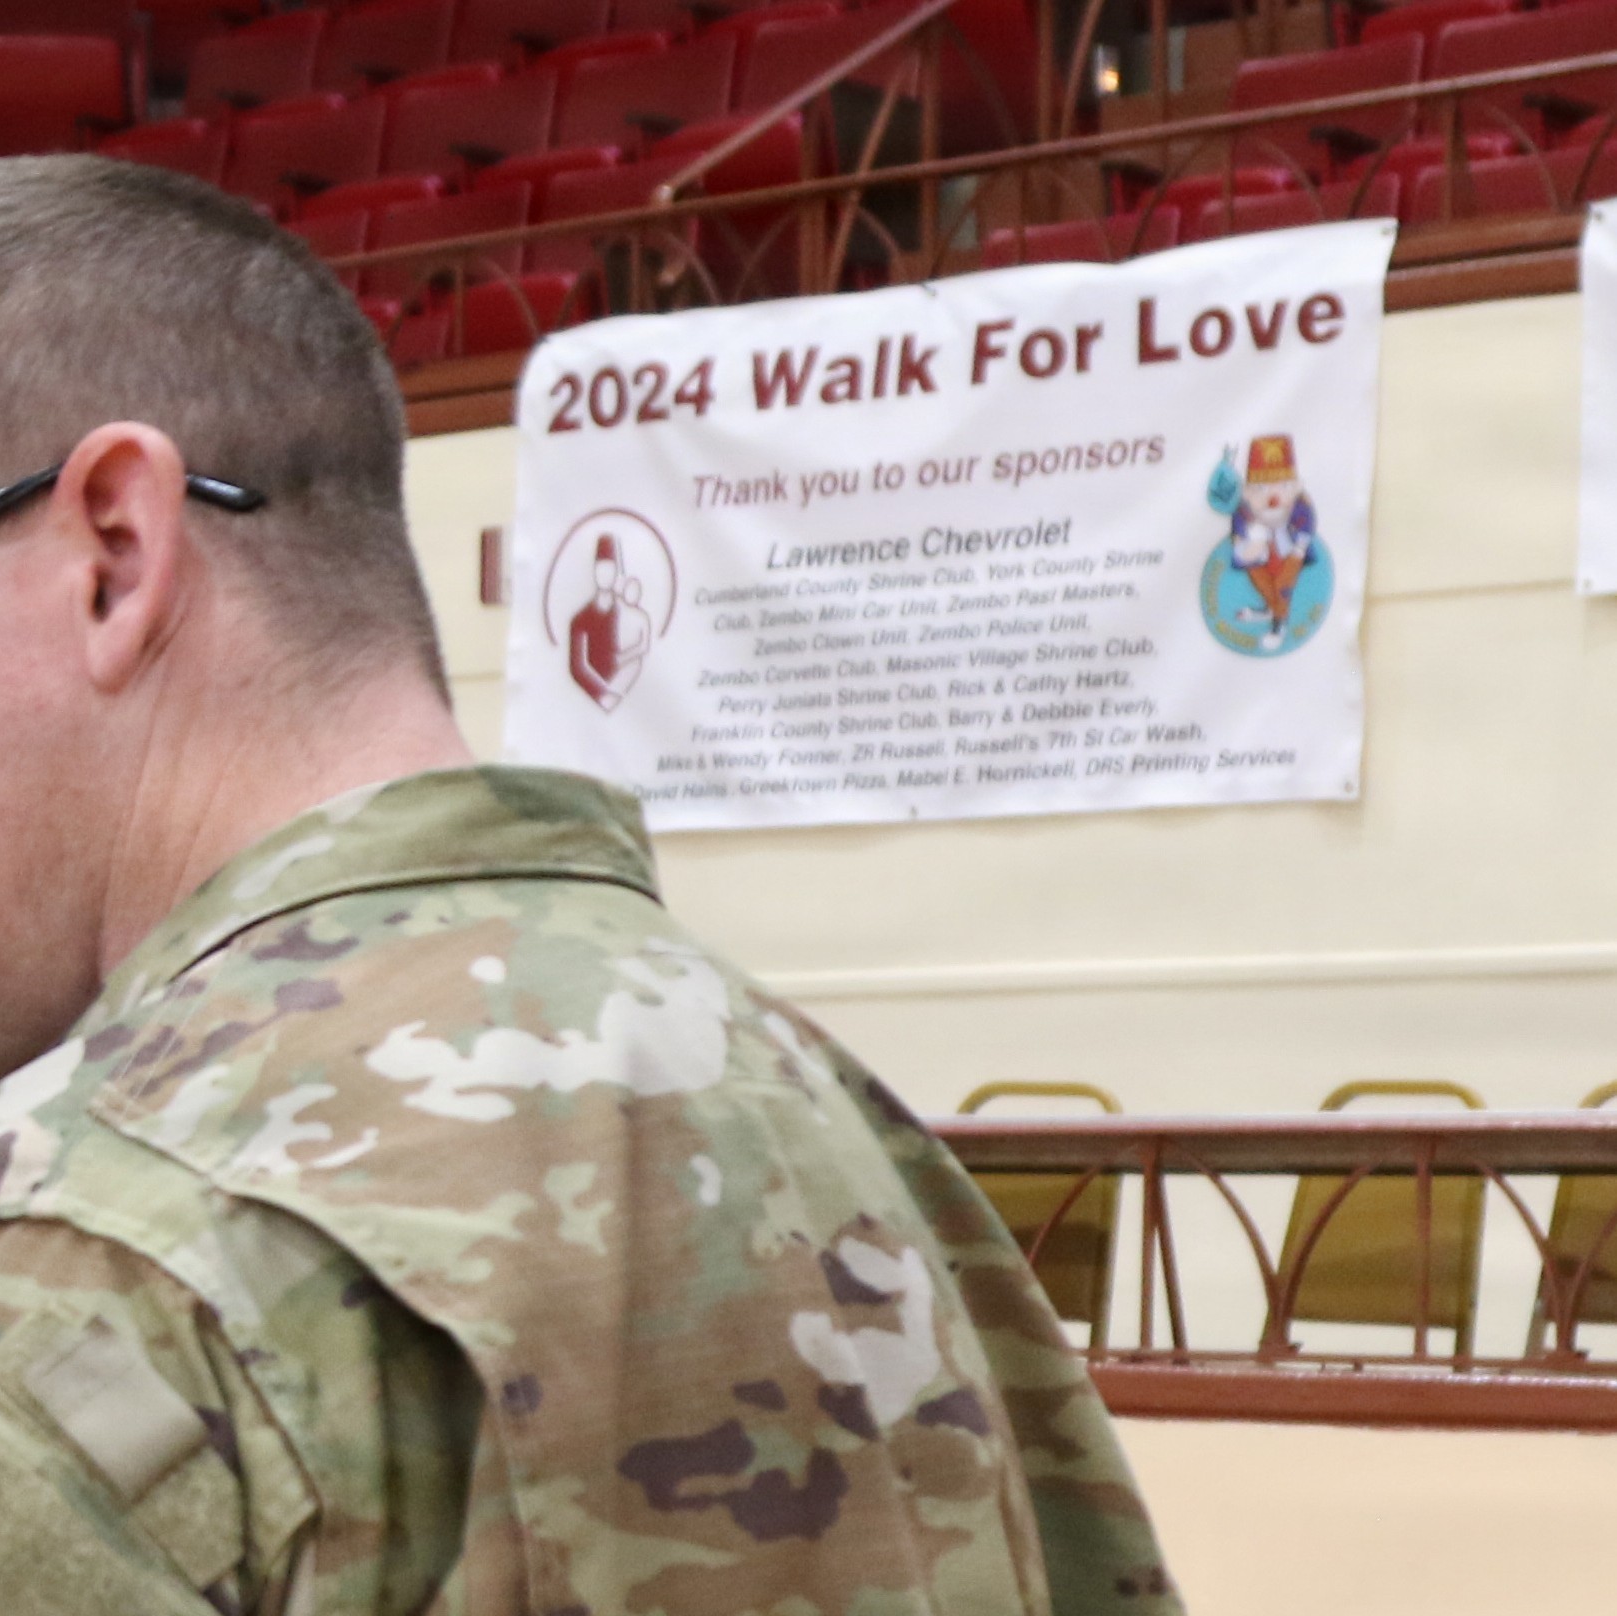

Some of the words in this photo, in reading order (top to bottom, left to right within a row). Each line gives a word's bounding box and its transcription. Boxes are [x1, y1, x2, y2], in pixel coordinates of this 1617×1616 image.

[547, 357, 716, 434] 2024
[752, 332, 937, 411] Walk
[971, 318, 1103, 385] For
[1137, 291, 1346, 365] Love
[694, 469, 788, 507] Thank
[800, 466, 858, 507] you
[873, 460, 904, 491] to
[917, 454, 980, 486] our
[992, 435, 1165, 487] sponsors
[767, 537, 910, 569] Lawrence
[922, 516, 1072, 557] Chevrolet
[695, 580, 789, 605] Cumberland
[795, 576, 859, 596] County
[868, 572, 926, 590] Shrine
[988, 562, 1024, 579] York
[1033, 555, 1097, 576] County
[1103, 549, 1164, 569] Shrine
[759, 608, 812, 627] Zembo
[819, 604, 856, 622] Mini
[863, 601, 891, 619] Car
[947, 593, 1010, 613] Zembo
[1017, 588, 1057, 606] Past
[1062, 581, 1139, 601] Masters,
[754, 637, 806, 656] Zembo
[813, 633, 865, 649] Clown
[919, 622, 981, 643] Zembo
[987, 618, 1043, 637] Police
[1049, 613, 1091, 633] Unit,
[697, 670, 760, 687] Zembo
[765, 665, 831, 682] Corvette
[887, 652, 959, 672] Masonic
[969, 647, 1028, 668] Village
[1035, 642, 1097, 662] Shrine
[1104, 636, 1157, 657] Club,
[719, 696, 765, 715] Perry
[773, 692, 831, 711] Juniata
[838, 688, 891, 705] Shrine
[948, 679, 985, 697] Rick
[993, 678, 1005, 694] &
[1013, 674, 1067, 695] Cathy
[692, 724, 763, 741] Franklin
[771, 721, 831, 740] County
[838, 716, 893, 733] Shrine
[949, 708, 993, 728] Barry
[1002, 706, 1013, 723] &
[1022, 702, 1092, 721] Debbie
[712, 751, 769, 769] Wendy
[1047, 731, 1076, 748] 7th
[1084, 728, 1104, 747] St
[1109, 726, 1137, 745] Car
[1145, 722, 1207, 742] Wash,
[1132, 752, 1210, 773] Printing
[1217, 749, 1297, 767] Services
